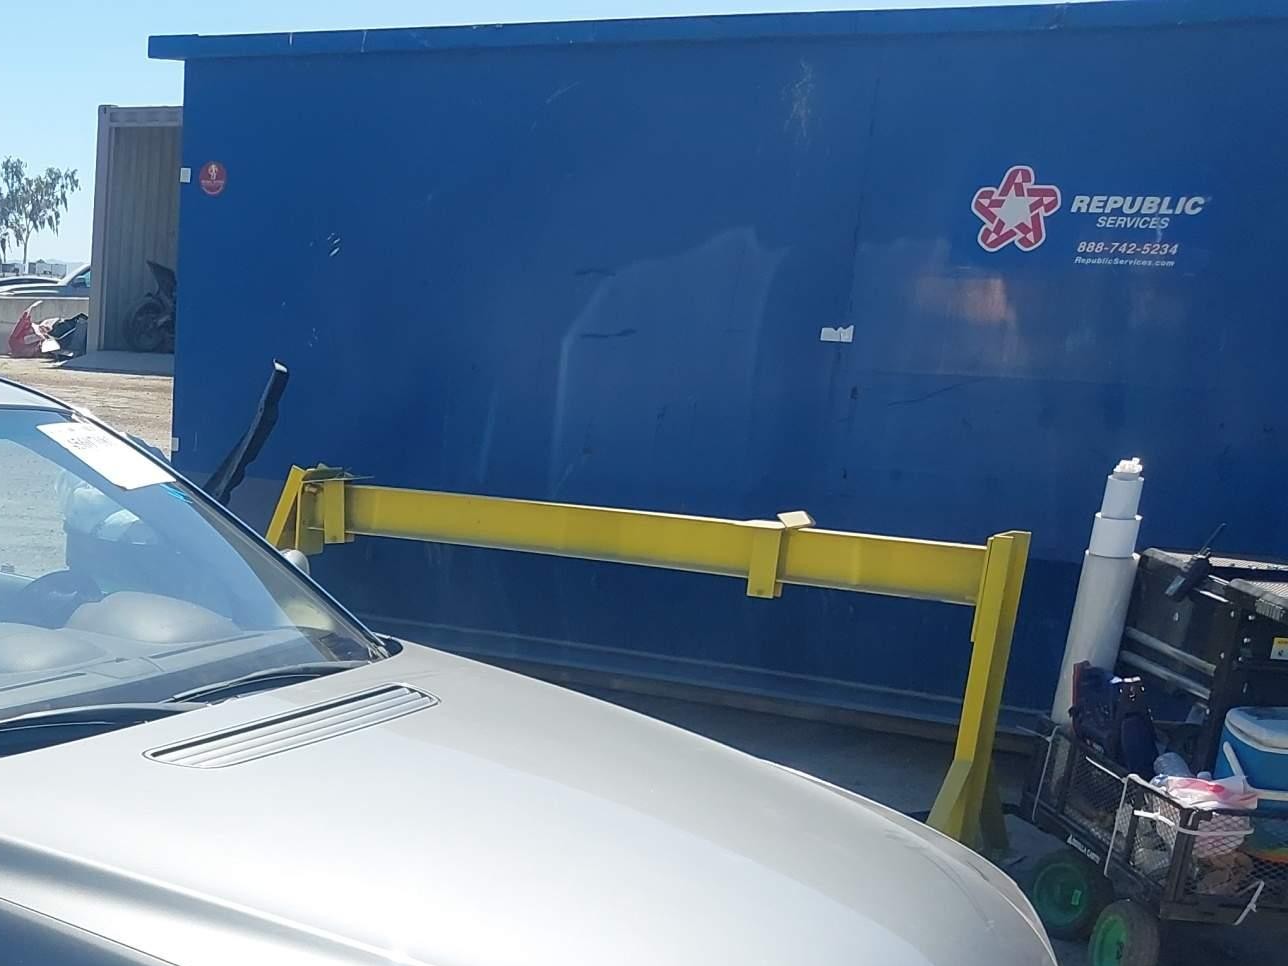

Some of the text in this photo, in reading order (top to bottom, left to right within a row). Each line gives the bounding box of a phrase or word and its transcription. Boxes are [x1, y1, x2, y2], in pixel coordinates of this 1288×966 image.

[1070, 195, 1205, 215] REPUBLIC
[1096, 216, 1171, 229] SERVICES
[1077, 242, 1179, 255] 888-742-5234
[1074, 256, 1175, 268] RepublicServices.com
